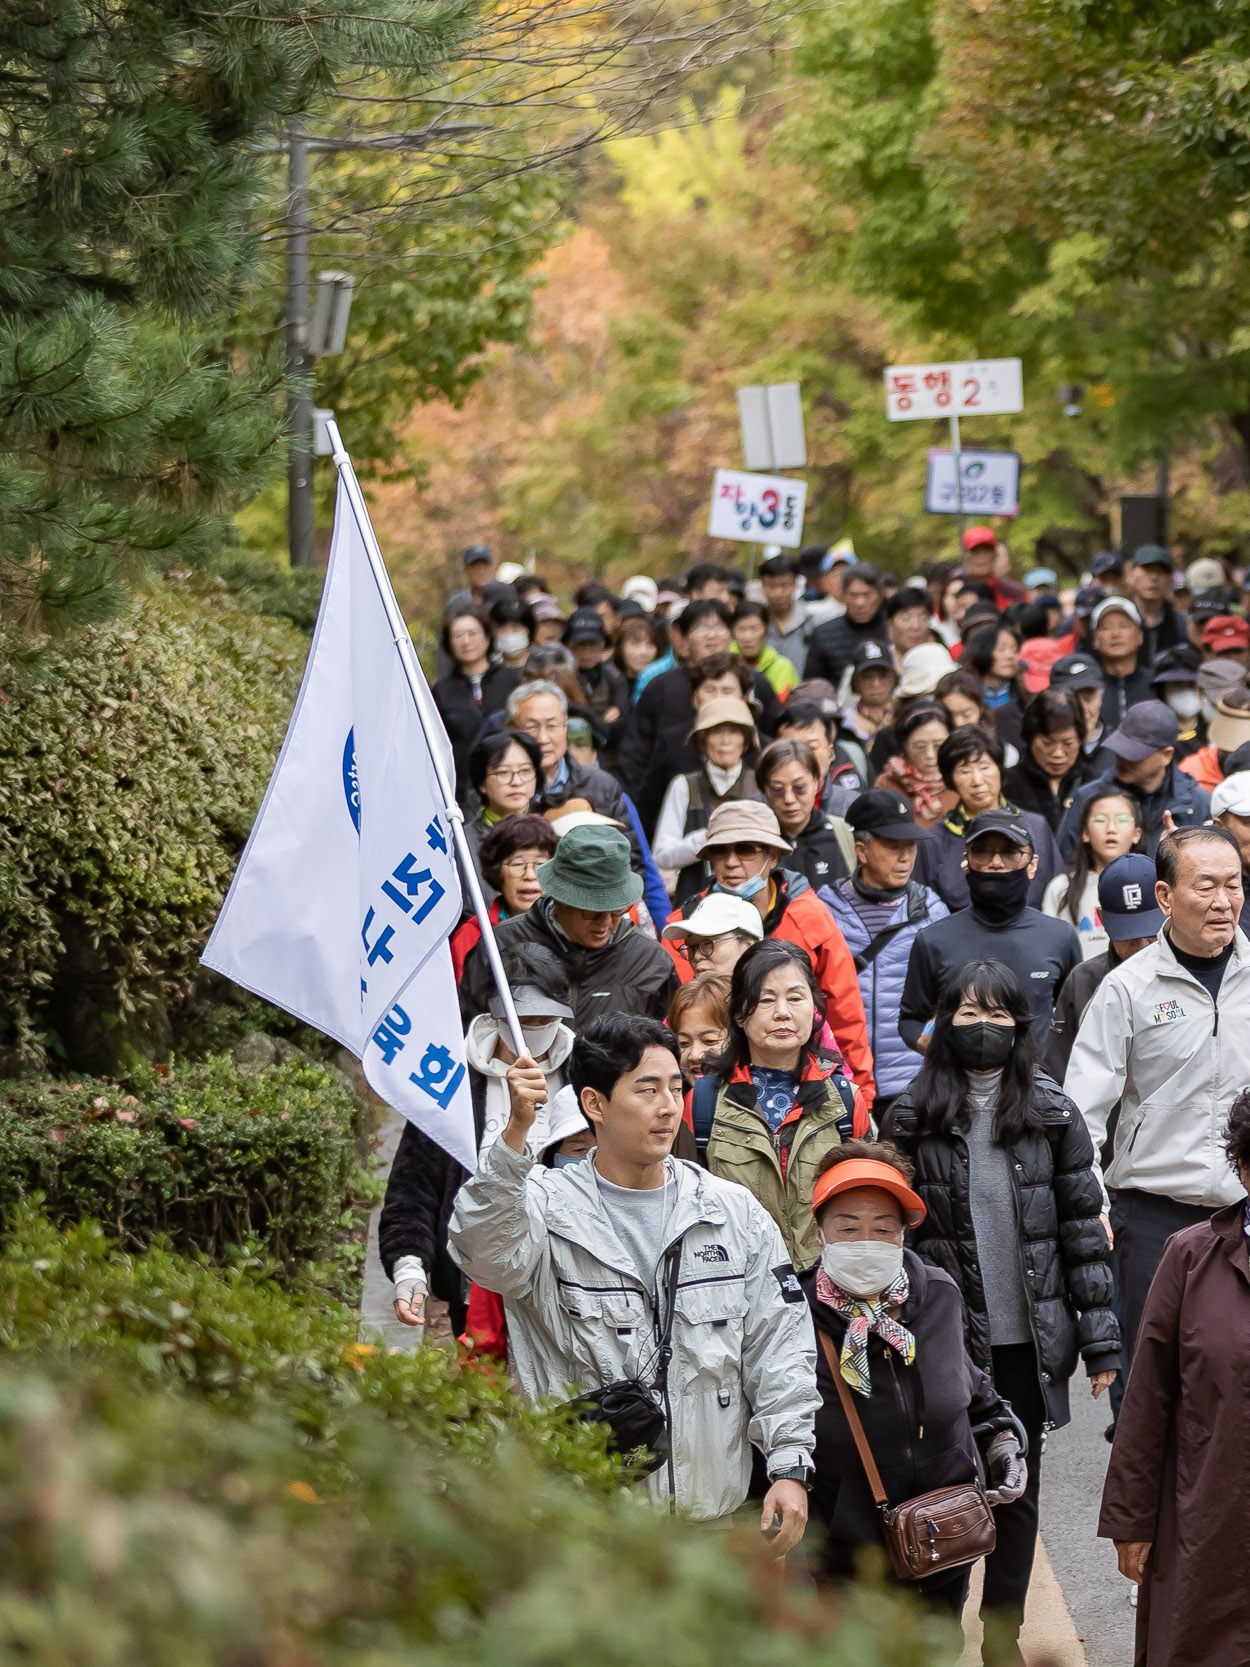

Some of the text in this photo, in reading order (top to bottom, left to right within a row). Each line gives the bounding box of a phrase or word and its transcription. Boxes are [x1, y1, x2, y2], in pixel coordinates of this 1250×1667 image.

[889, 371, 952, 411] 동행
[720, 484, 797, 531] 자양3동
[693, 1250, 720, 1258] NORTH
